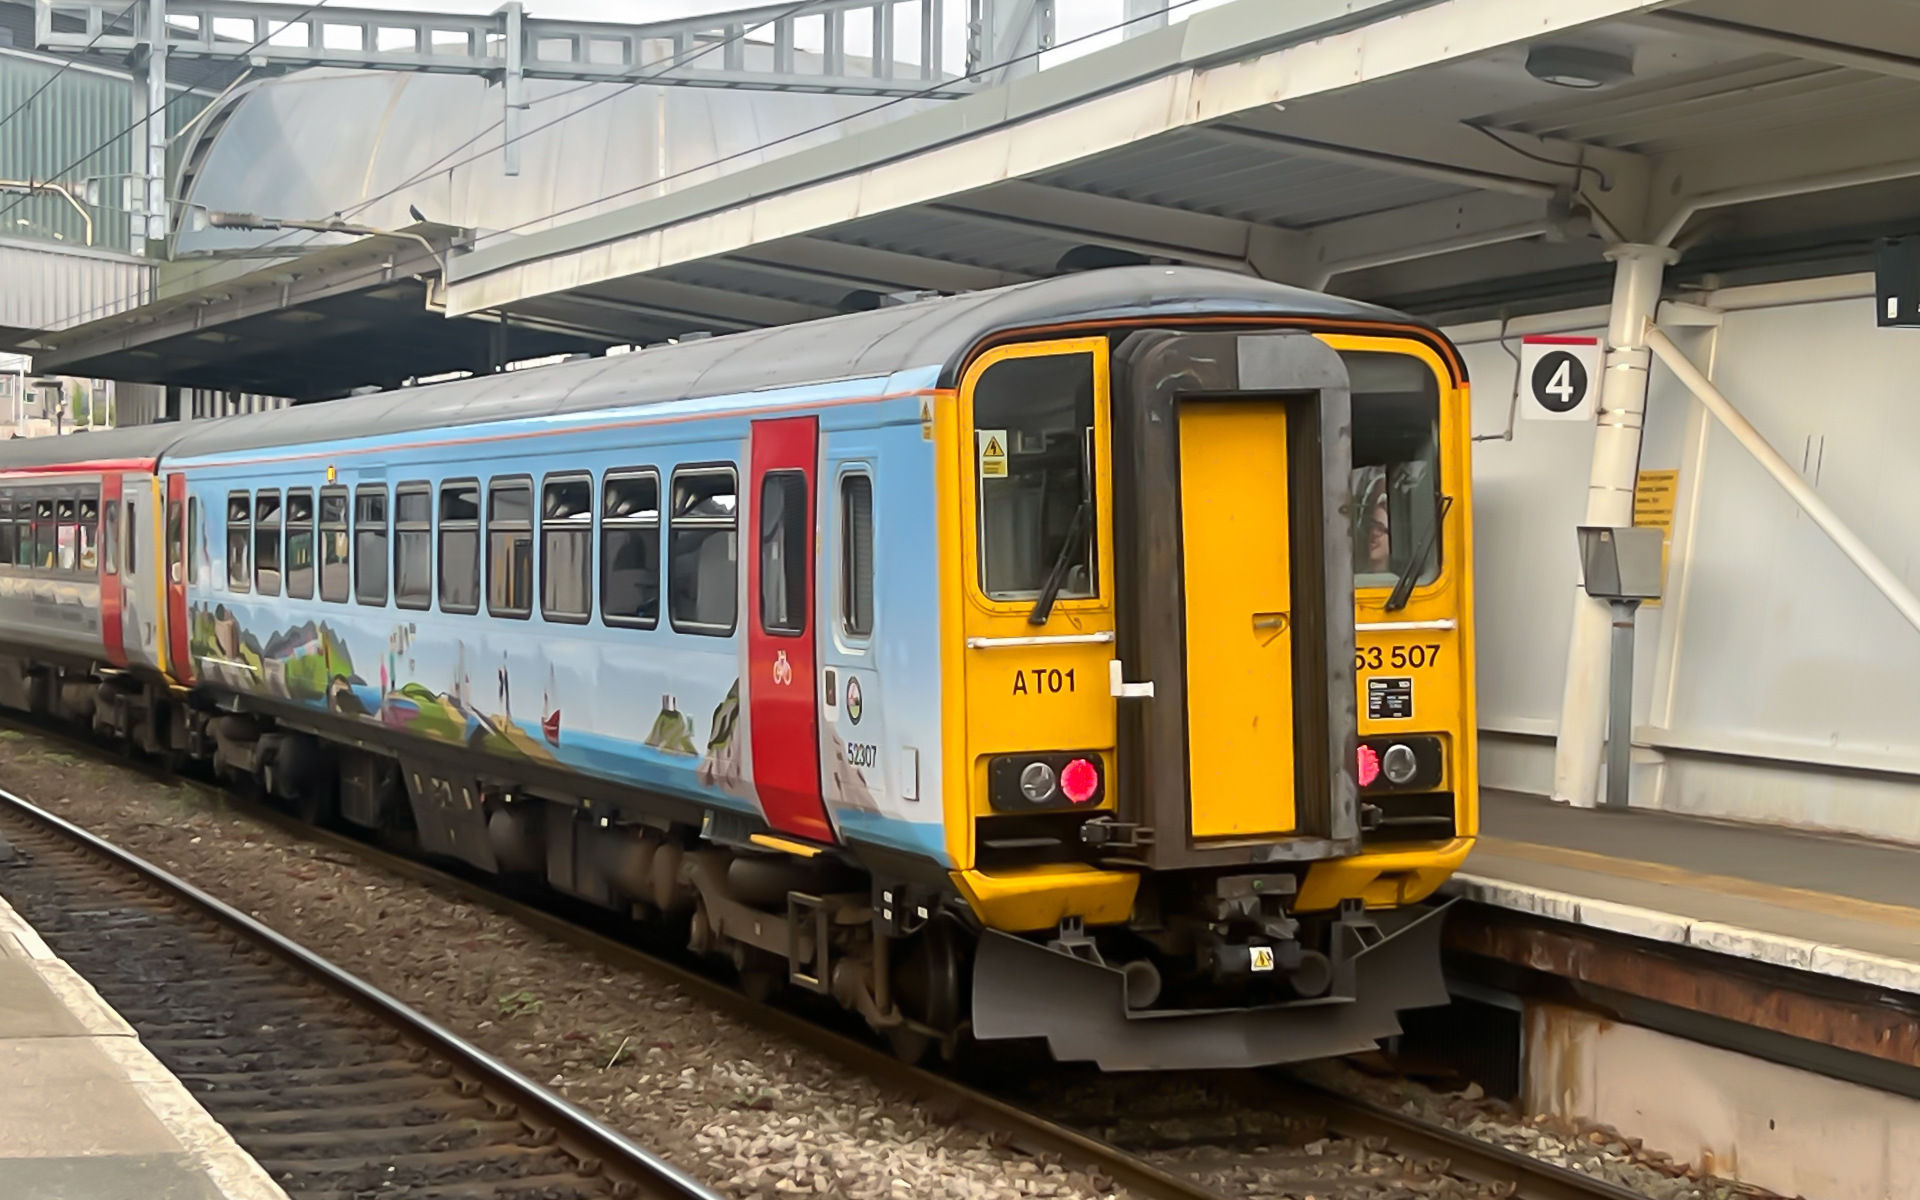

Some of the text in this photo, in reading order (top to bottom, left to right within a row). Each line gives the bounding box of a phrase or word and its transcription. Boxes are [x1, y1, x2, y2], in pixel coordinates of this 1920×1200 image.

[1545, 360, 1574, 402] 4
[1391, 644, 1440, 668] 507
[848, 742, 877, 767] 52307
